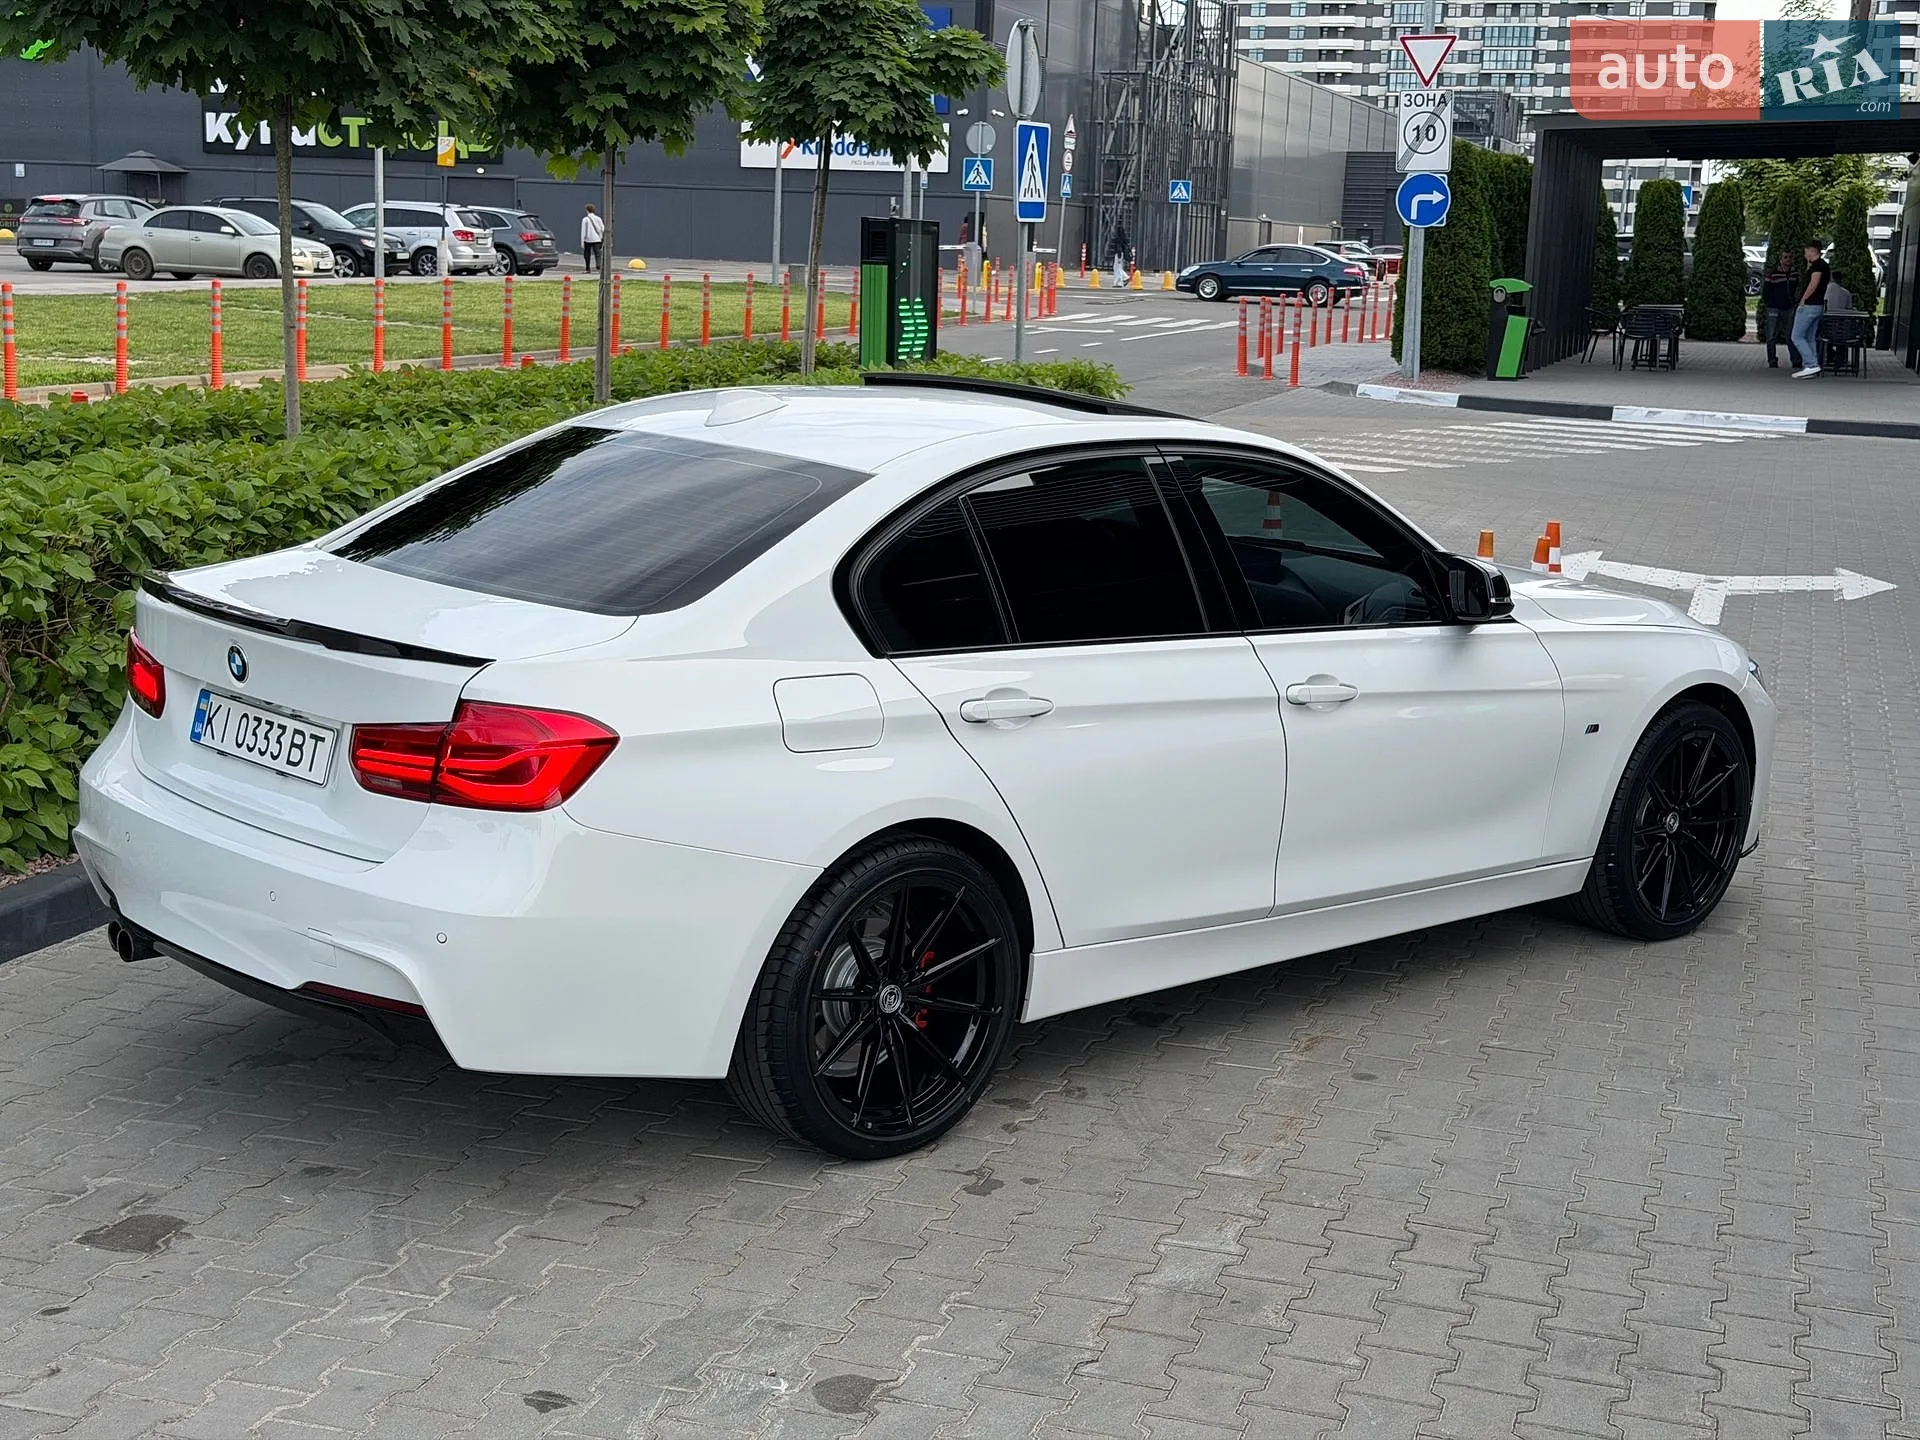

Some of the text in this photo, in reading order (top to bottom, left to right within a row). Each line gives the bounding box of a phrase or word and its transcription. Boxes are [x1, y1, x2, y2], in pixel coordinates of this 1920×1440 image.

[1403, 93, 1448, 108] ЗОНА
[1412, 124, 1437, 142] 10
[203, 701, 231, 744] KI
